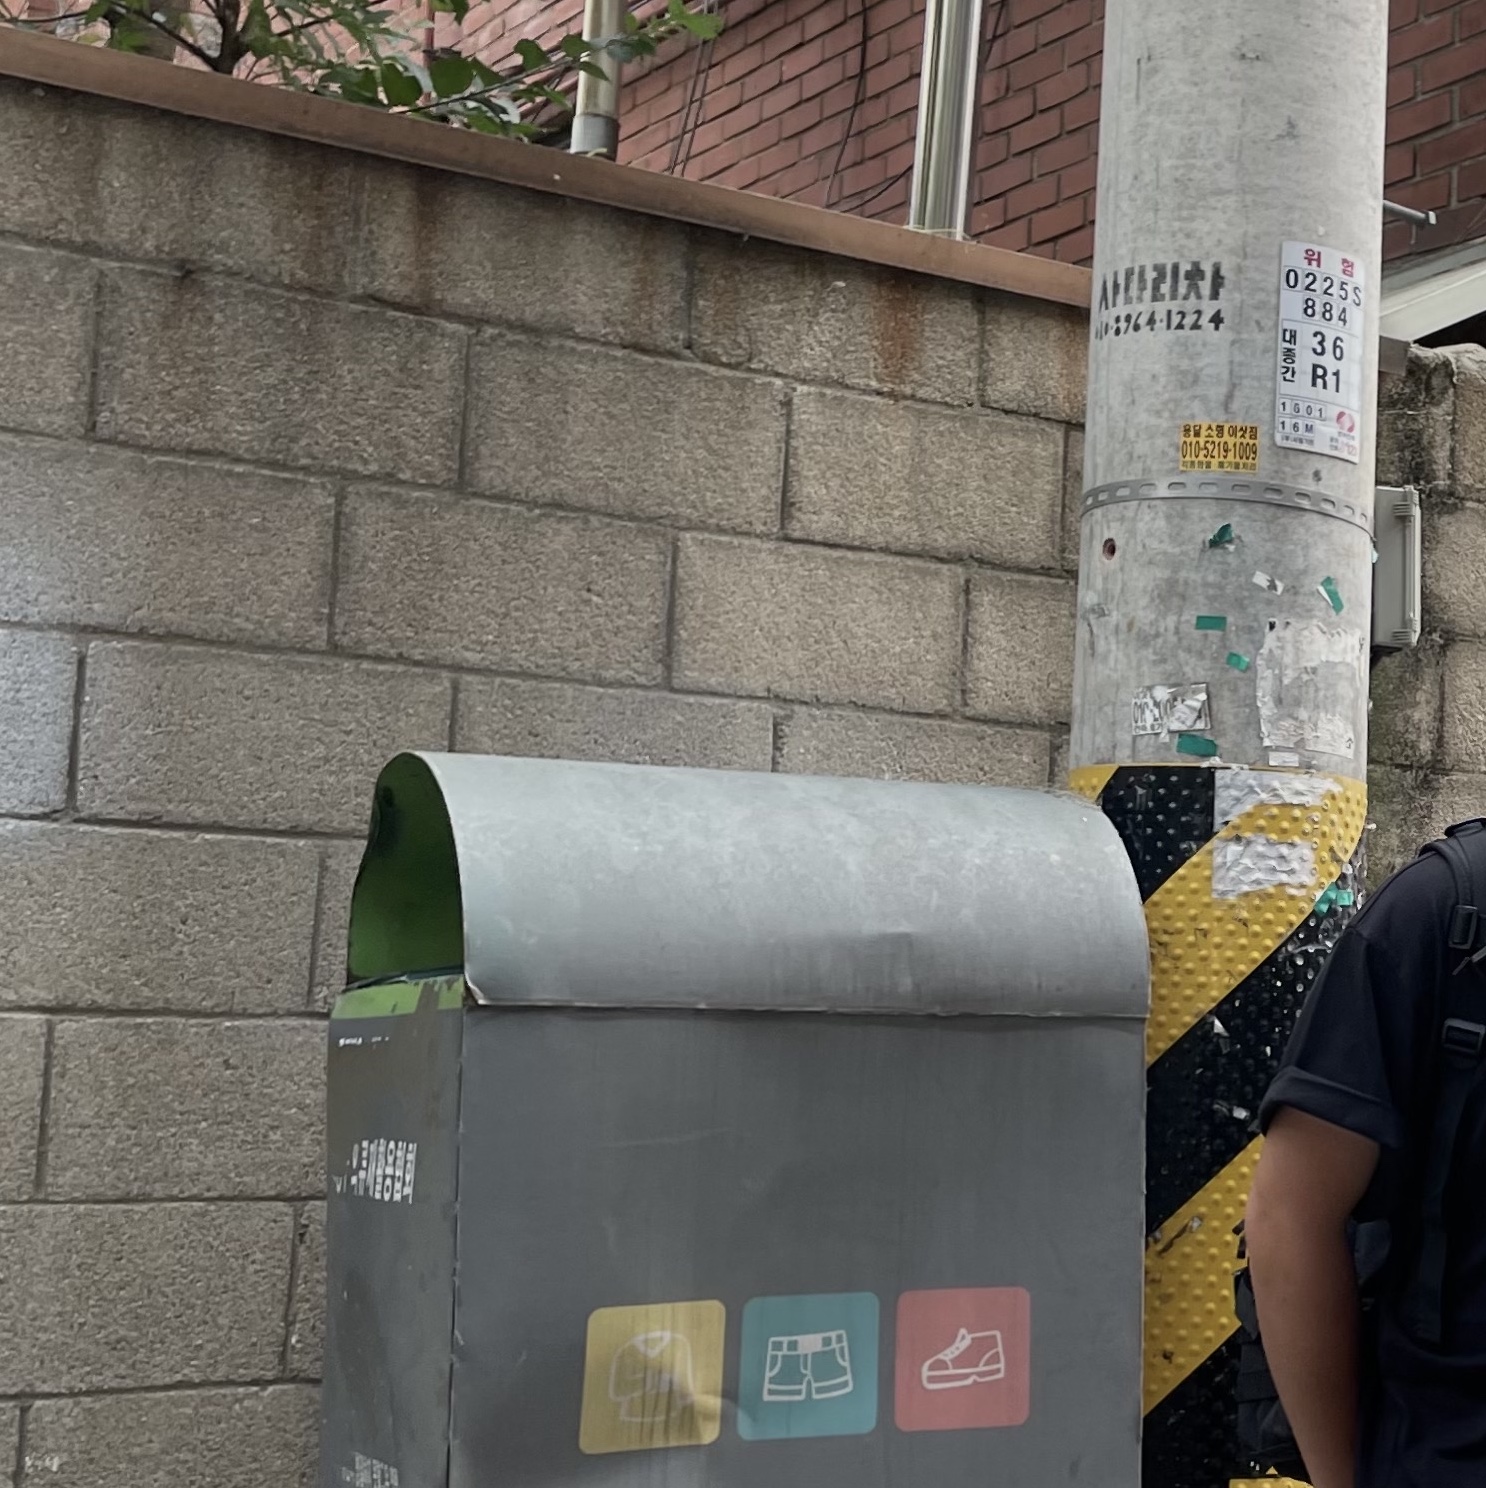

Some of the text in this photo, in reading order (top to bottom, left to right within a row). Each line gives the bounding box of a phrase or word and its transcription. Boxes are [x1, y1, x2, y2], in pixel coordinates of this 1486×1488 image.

[1285, 268, 1362, 307] 0225S
[1303, 297, 1348, 326] 884
[1311, 330, 1344, 361] 36
[1311, 362, 1341, 393] R1
[1183, 424, 1257, 440] 용달 소형 이삿짐
[1181, 440, 1258, 460] 010-5219-1009
